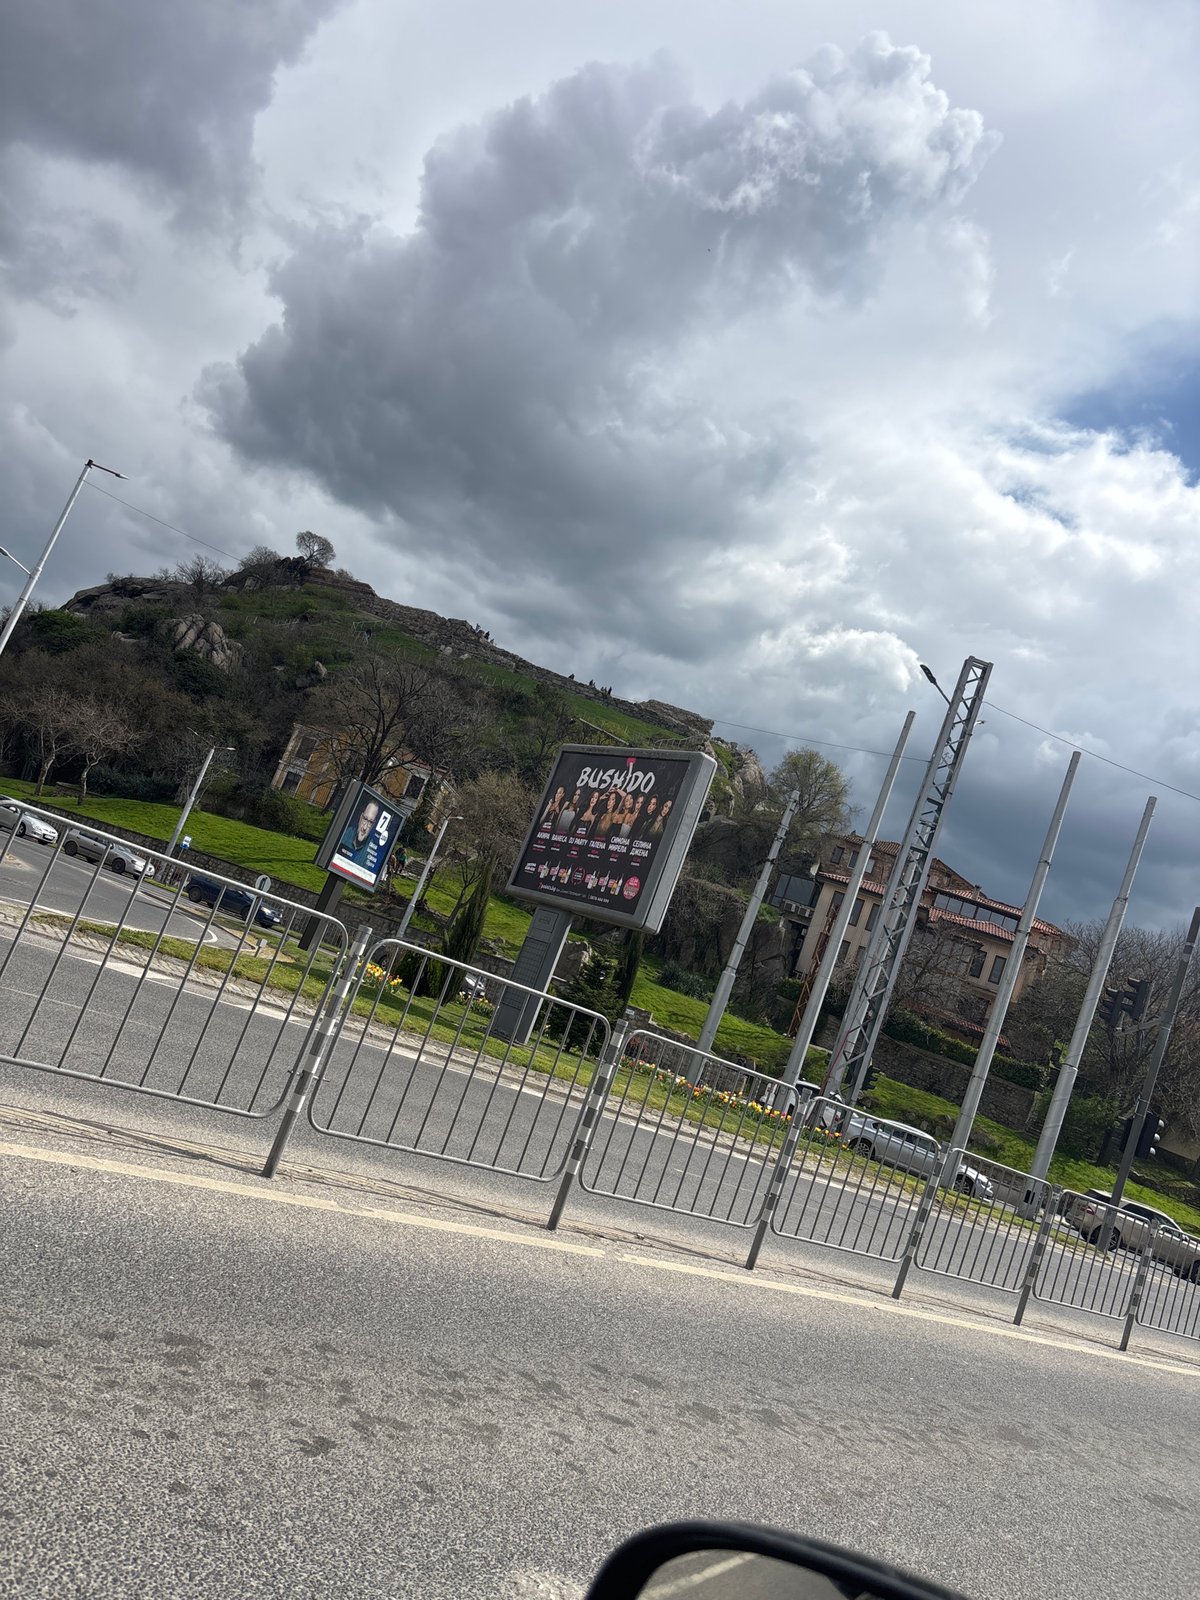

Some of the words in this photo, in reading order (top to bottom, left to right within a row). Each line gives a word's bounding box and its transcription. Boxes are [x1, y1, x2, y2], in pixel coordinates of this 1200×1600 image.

[576, 764, 656, 794] BUSHIDO
[551, 834, 568, 843] ВАНЕСА
[574, 838, 588, 847] PARTY
[611, 836, 631, 846] СИМОНА
[588, 840, 607, 850] ГАЛЕНА
[608, 844, 628, 853] МИРЕЛА
[632, 840, 652, 850] СЕЛИНА
[629, 847, 649, 858] ДЖЕНА
